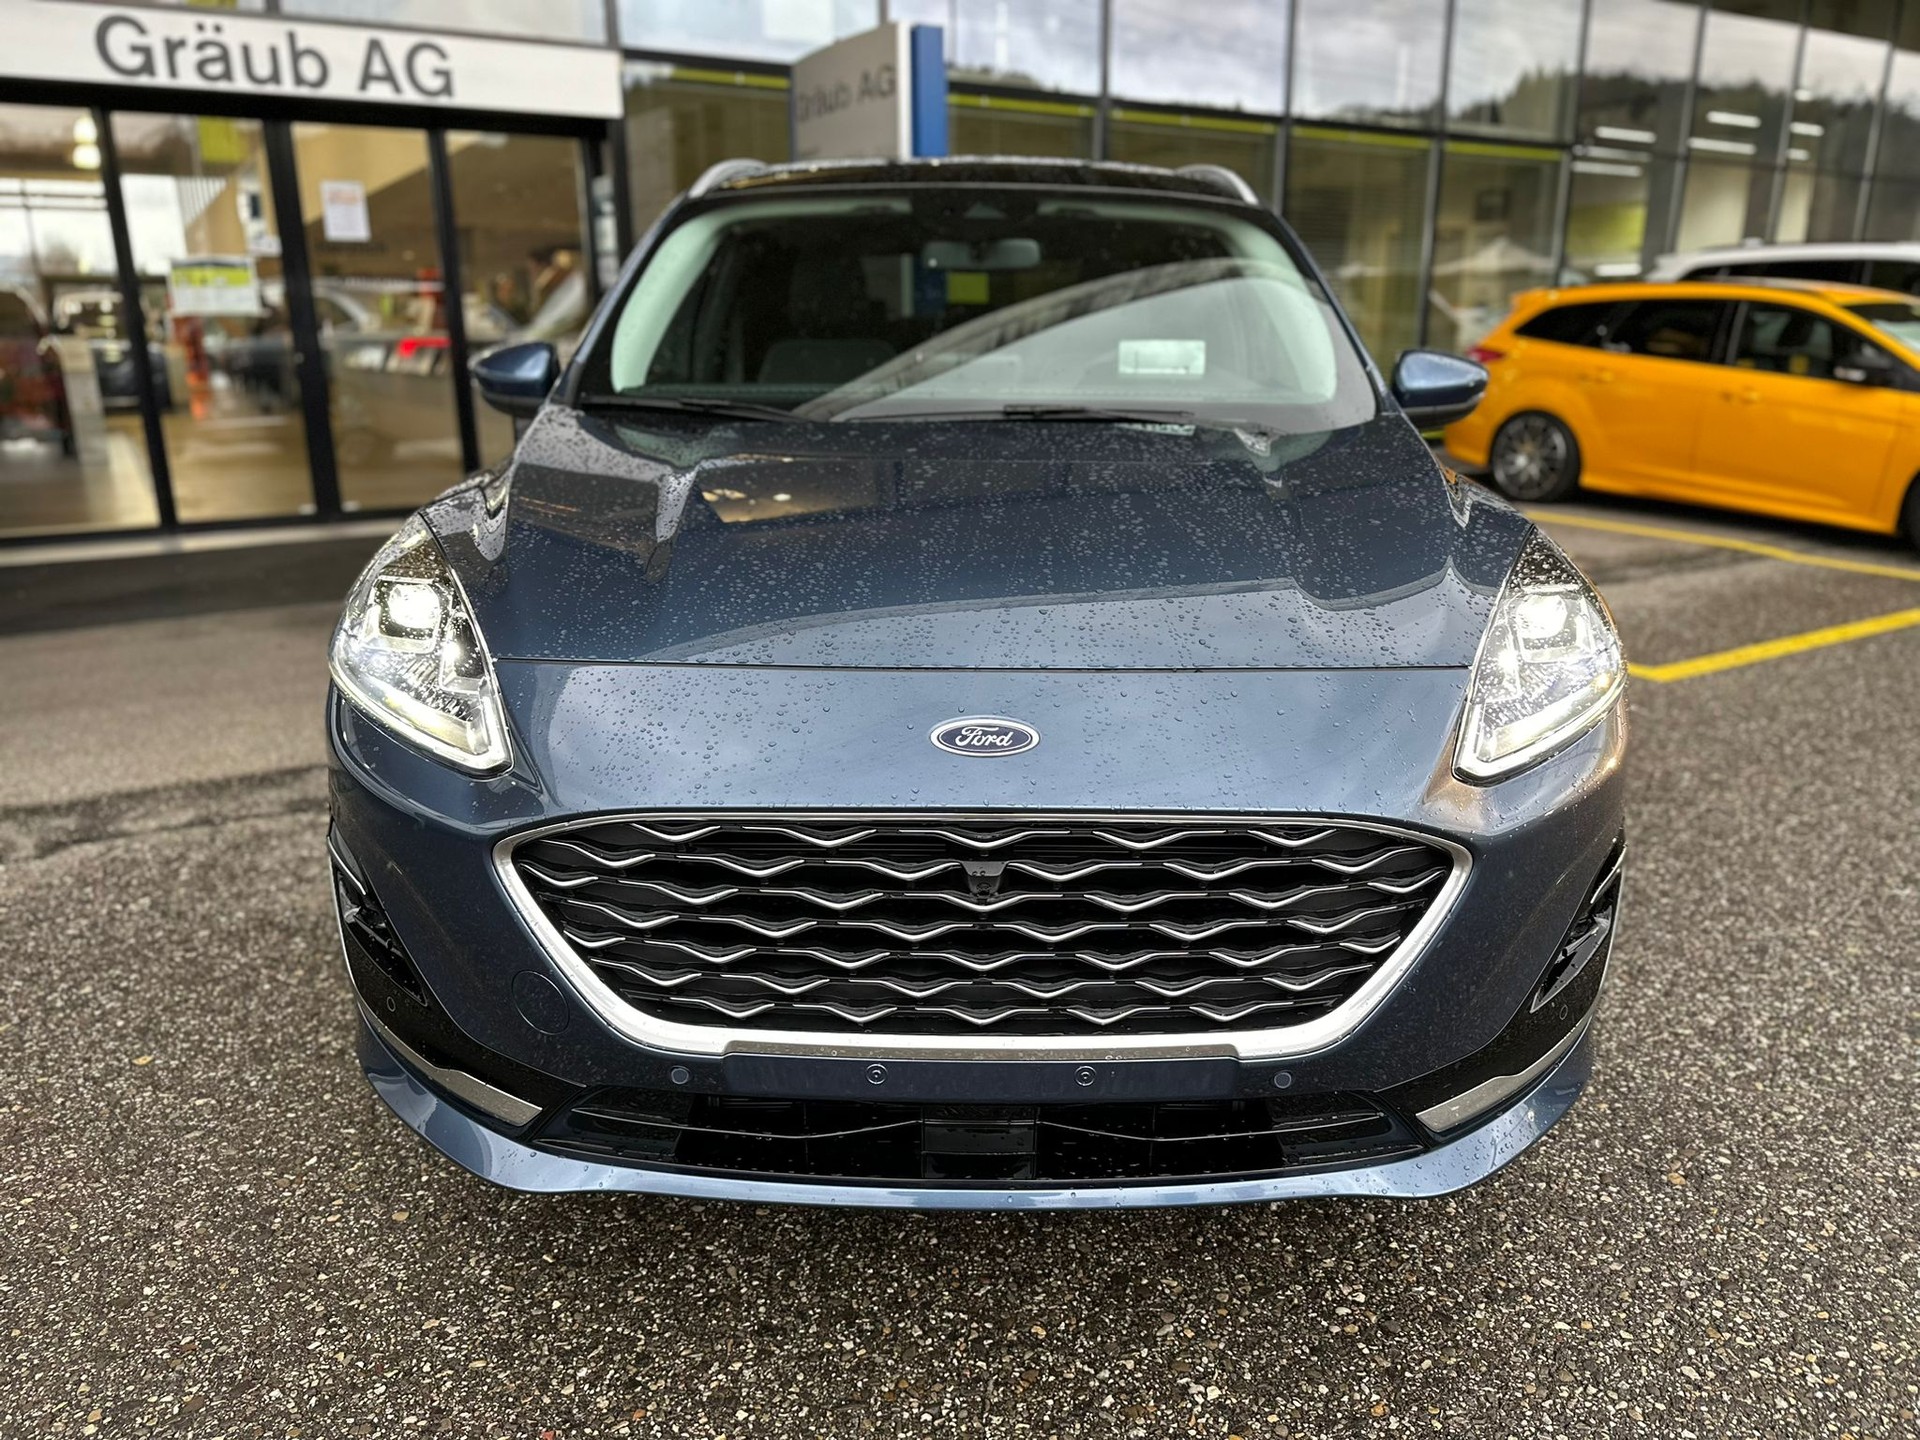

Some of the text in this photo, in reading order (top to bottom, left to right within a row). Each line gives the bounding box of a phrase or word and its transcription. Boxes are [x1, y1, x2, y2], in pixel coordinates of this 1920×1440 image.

[95, 14, 454, 98] Gräub AG
[857, 64, 896, 105] AG
[955, 726, 1013, 746] Ford
